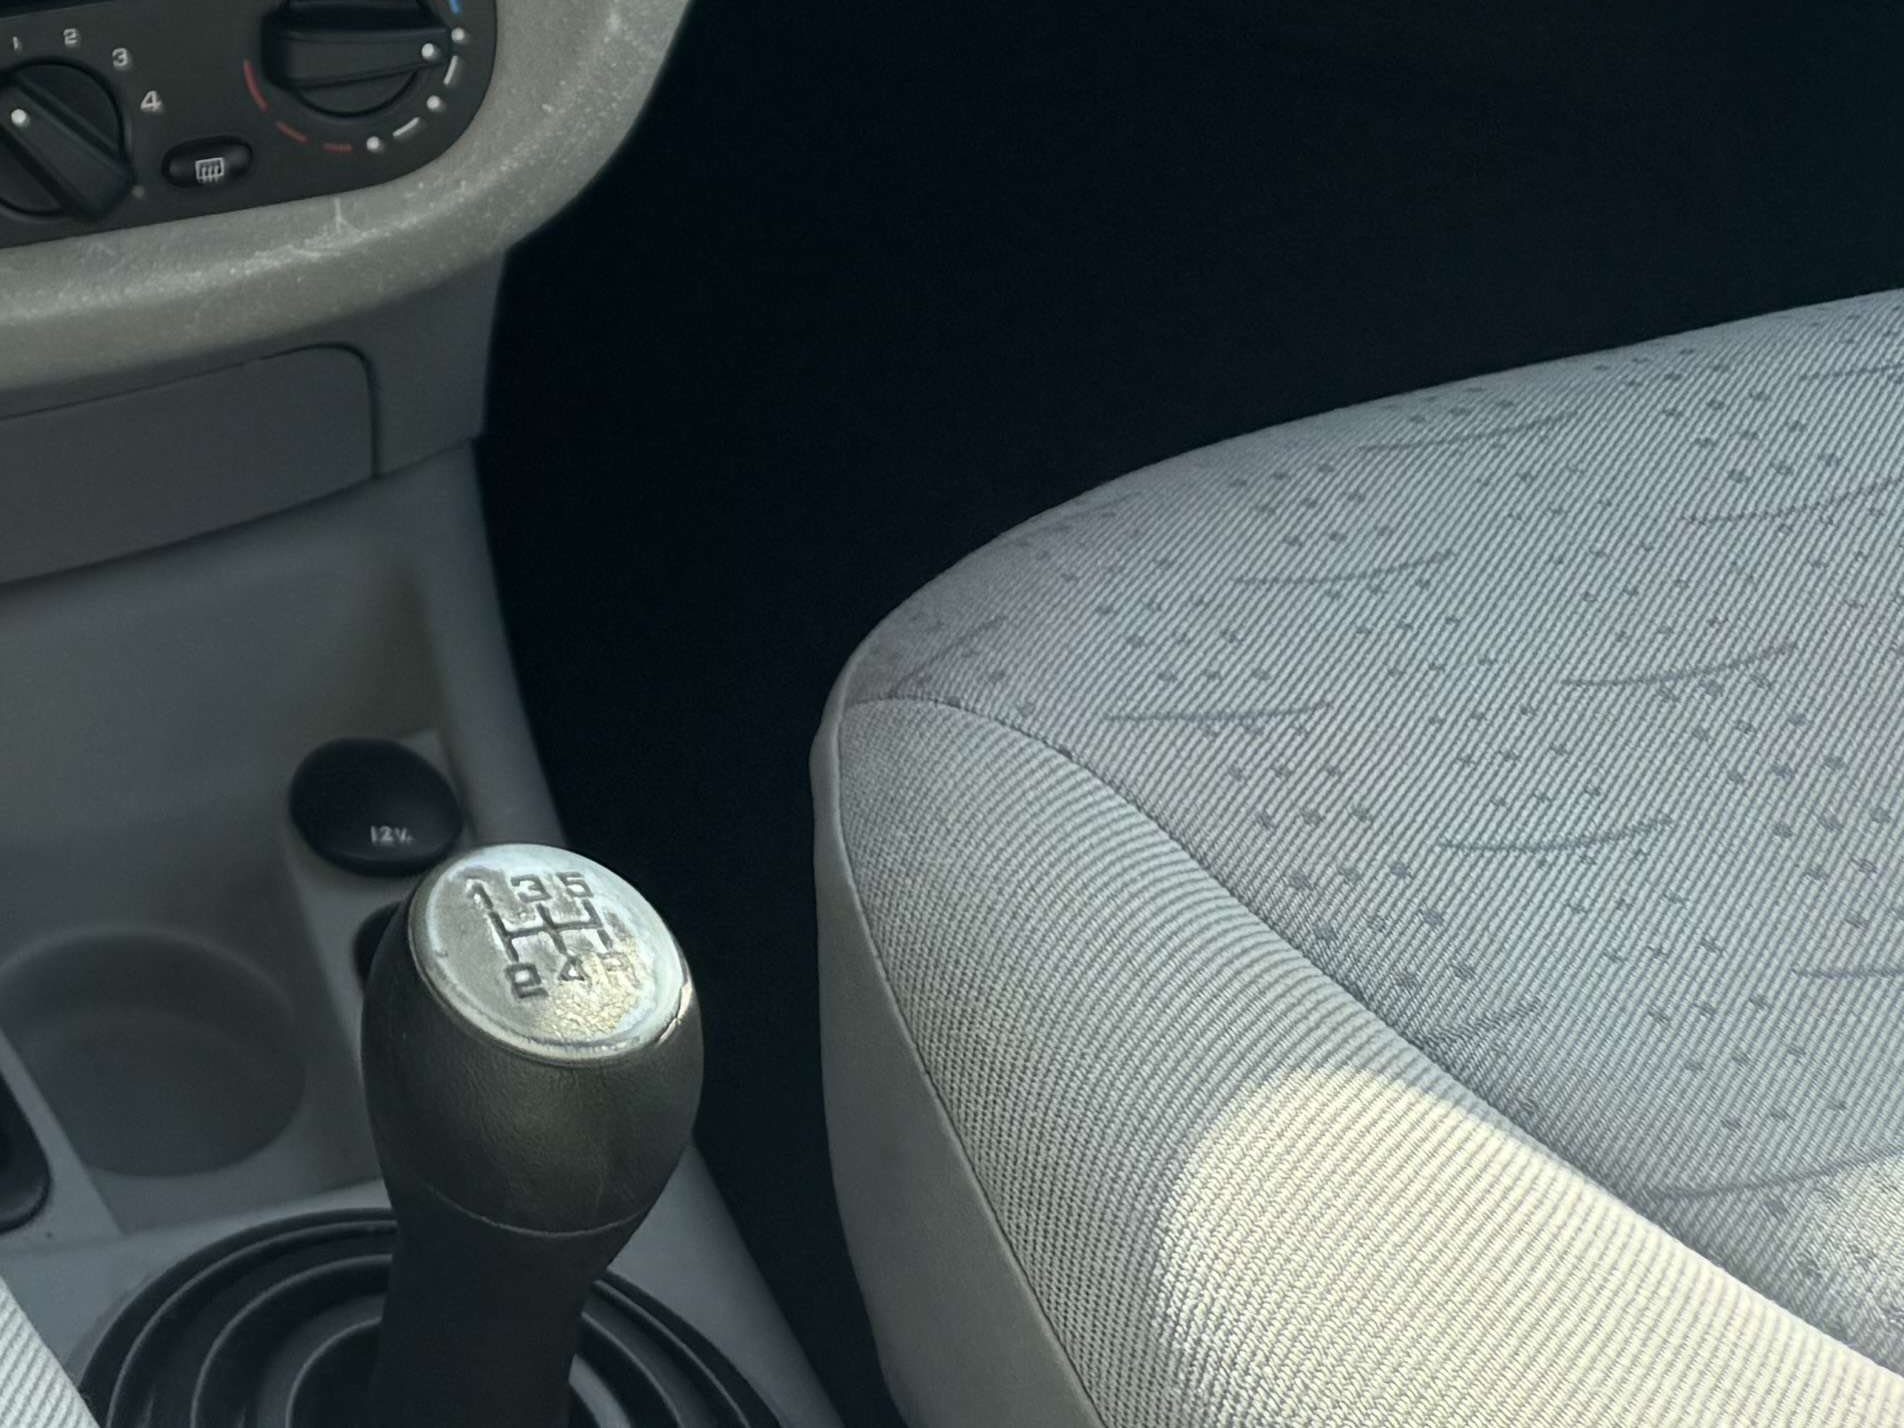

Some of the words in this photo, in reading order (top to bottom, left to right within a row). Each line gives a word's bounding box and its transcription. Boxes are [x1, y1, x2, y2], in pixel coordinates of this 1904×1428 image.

[12, 35, 21, 52] 1
[63, 28, 79, 46] 2
[112, 47, 129, 67] 3
[140, 90, 162, 112] 4
[510, 874, 552, 904] 3
[556, 871, 594, 898] 5
[506, 963, 548, 999] 2
[558, 954, 588, 982] 4
